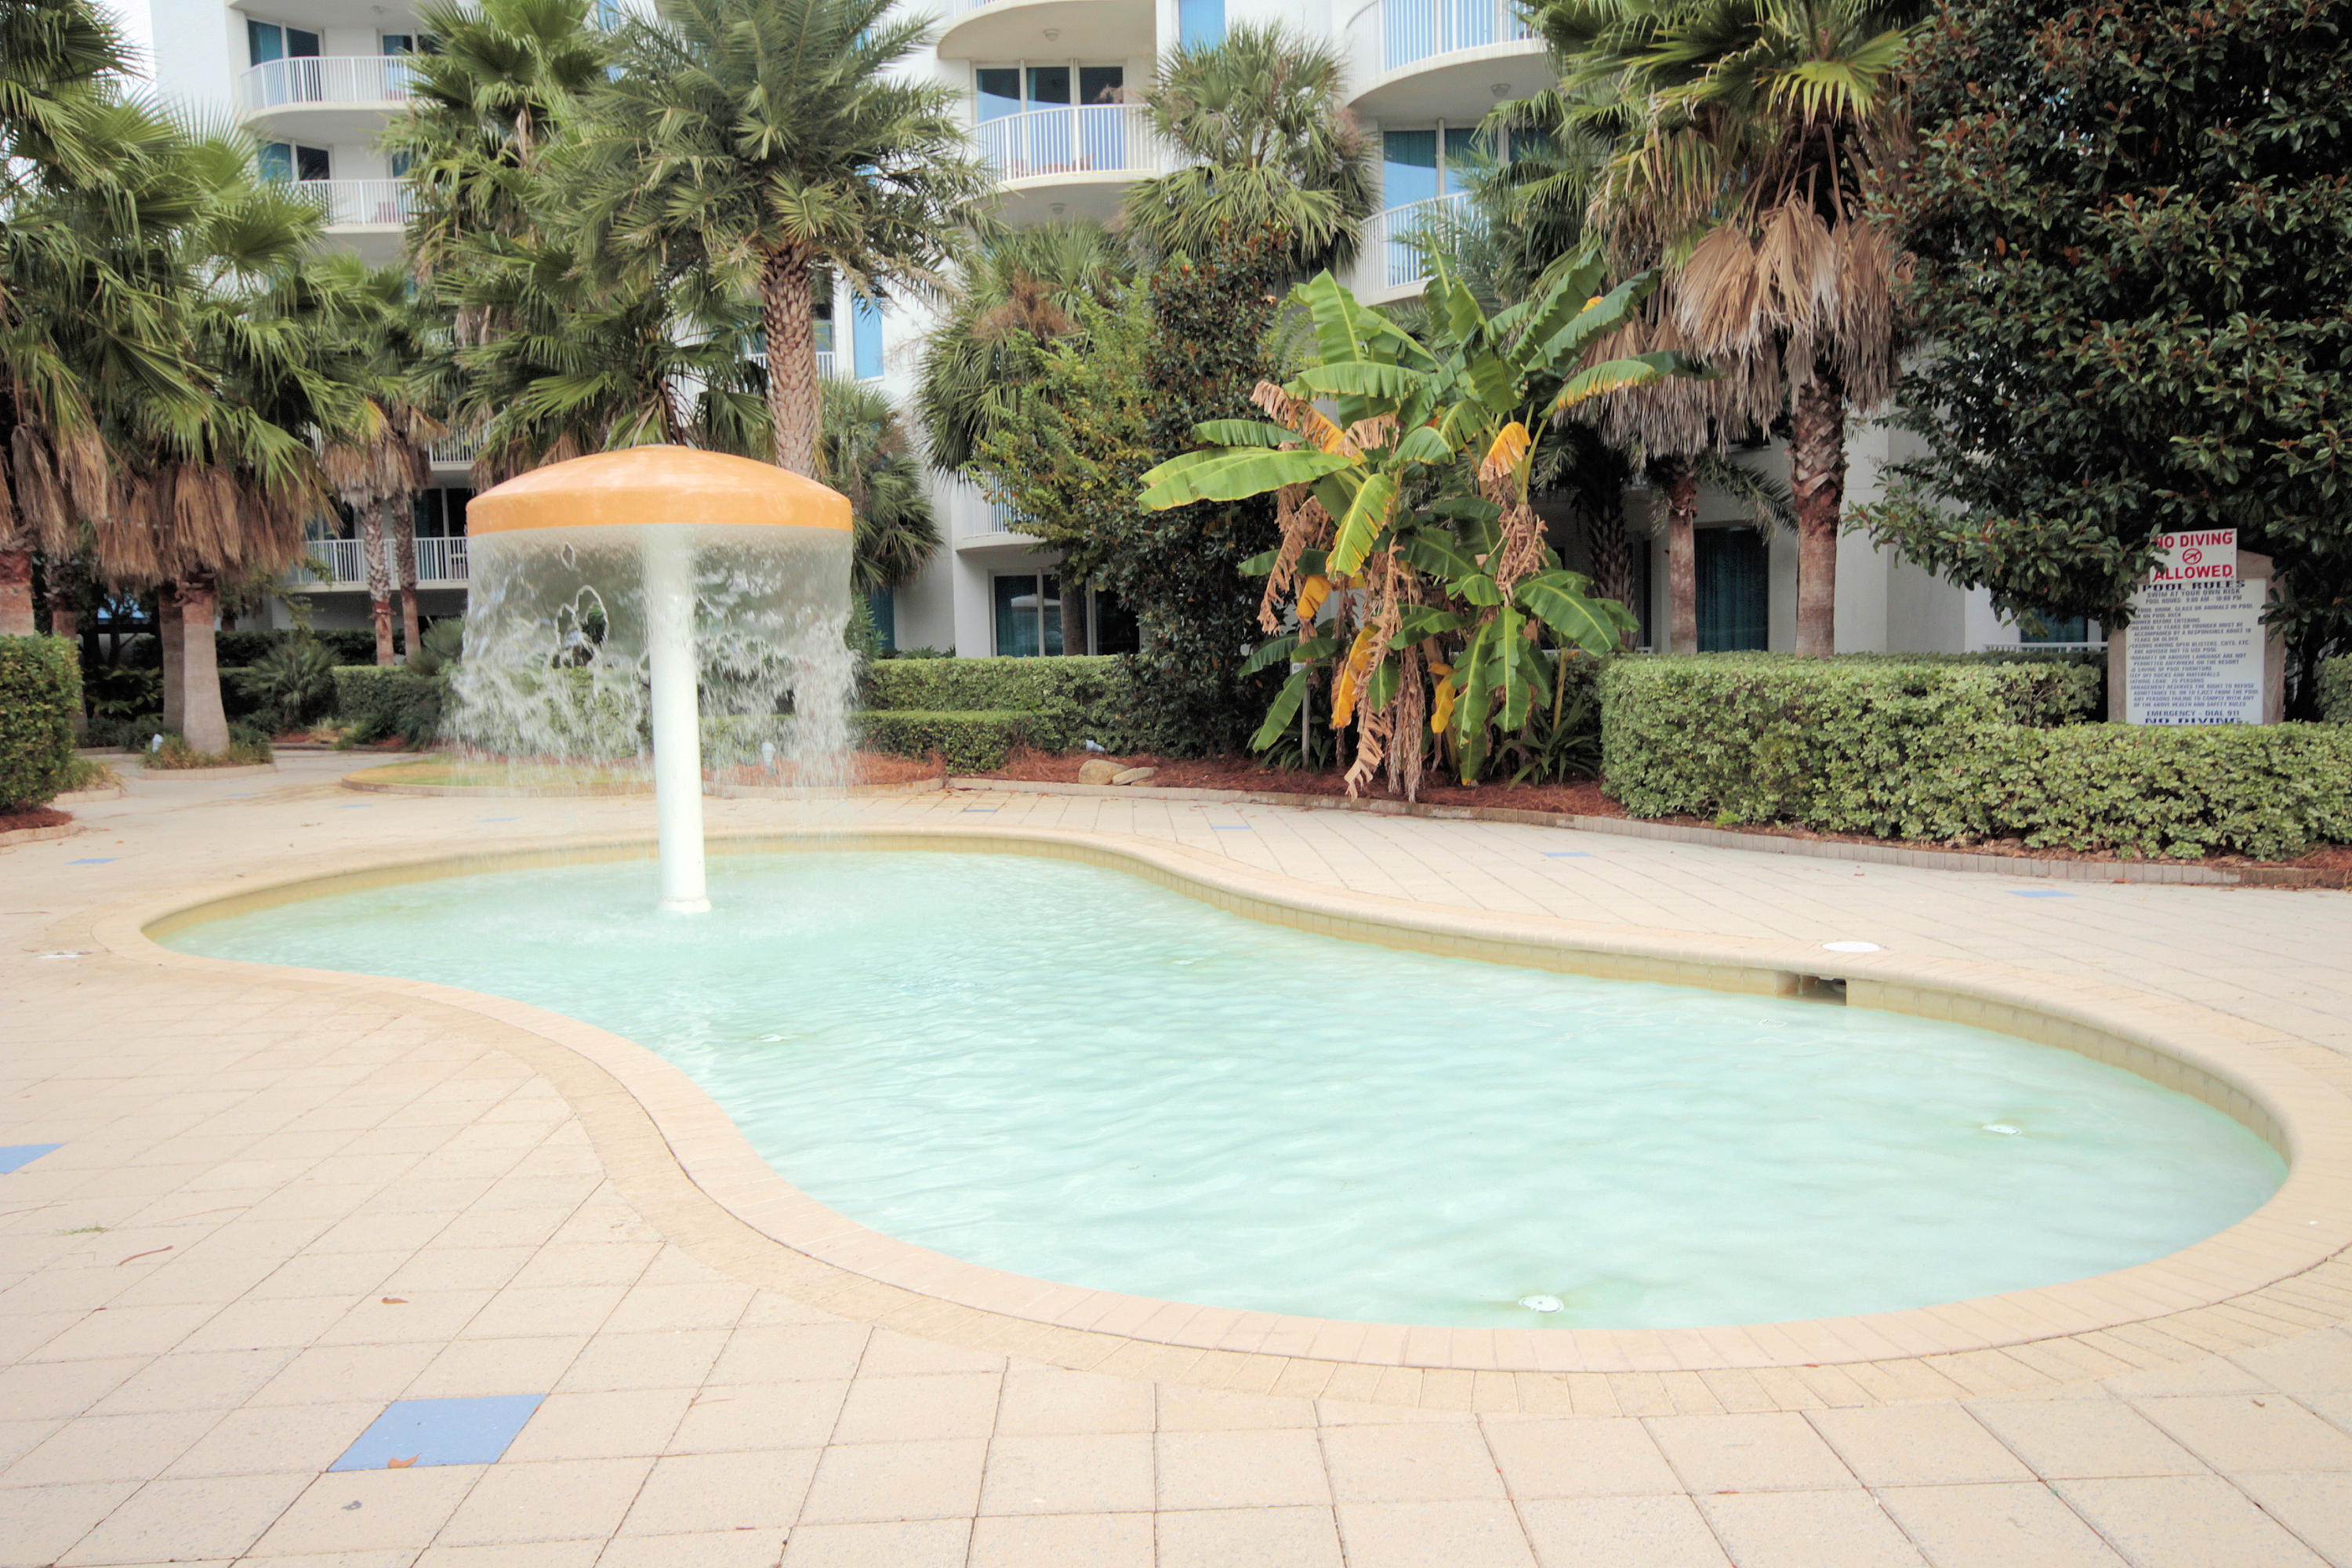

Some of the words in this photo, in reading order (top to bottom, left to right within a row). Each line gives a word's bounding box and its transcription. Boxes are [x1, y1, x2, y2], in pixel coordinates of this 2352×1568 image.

[2155, 535, 2174, 548] NO
[2180, 532, 2233, 547] DIVING
[2153, 564, 2233, 582] ALLOWED
[2193, 579, 2245, 589] RULES
